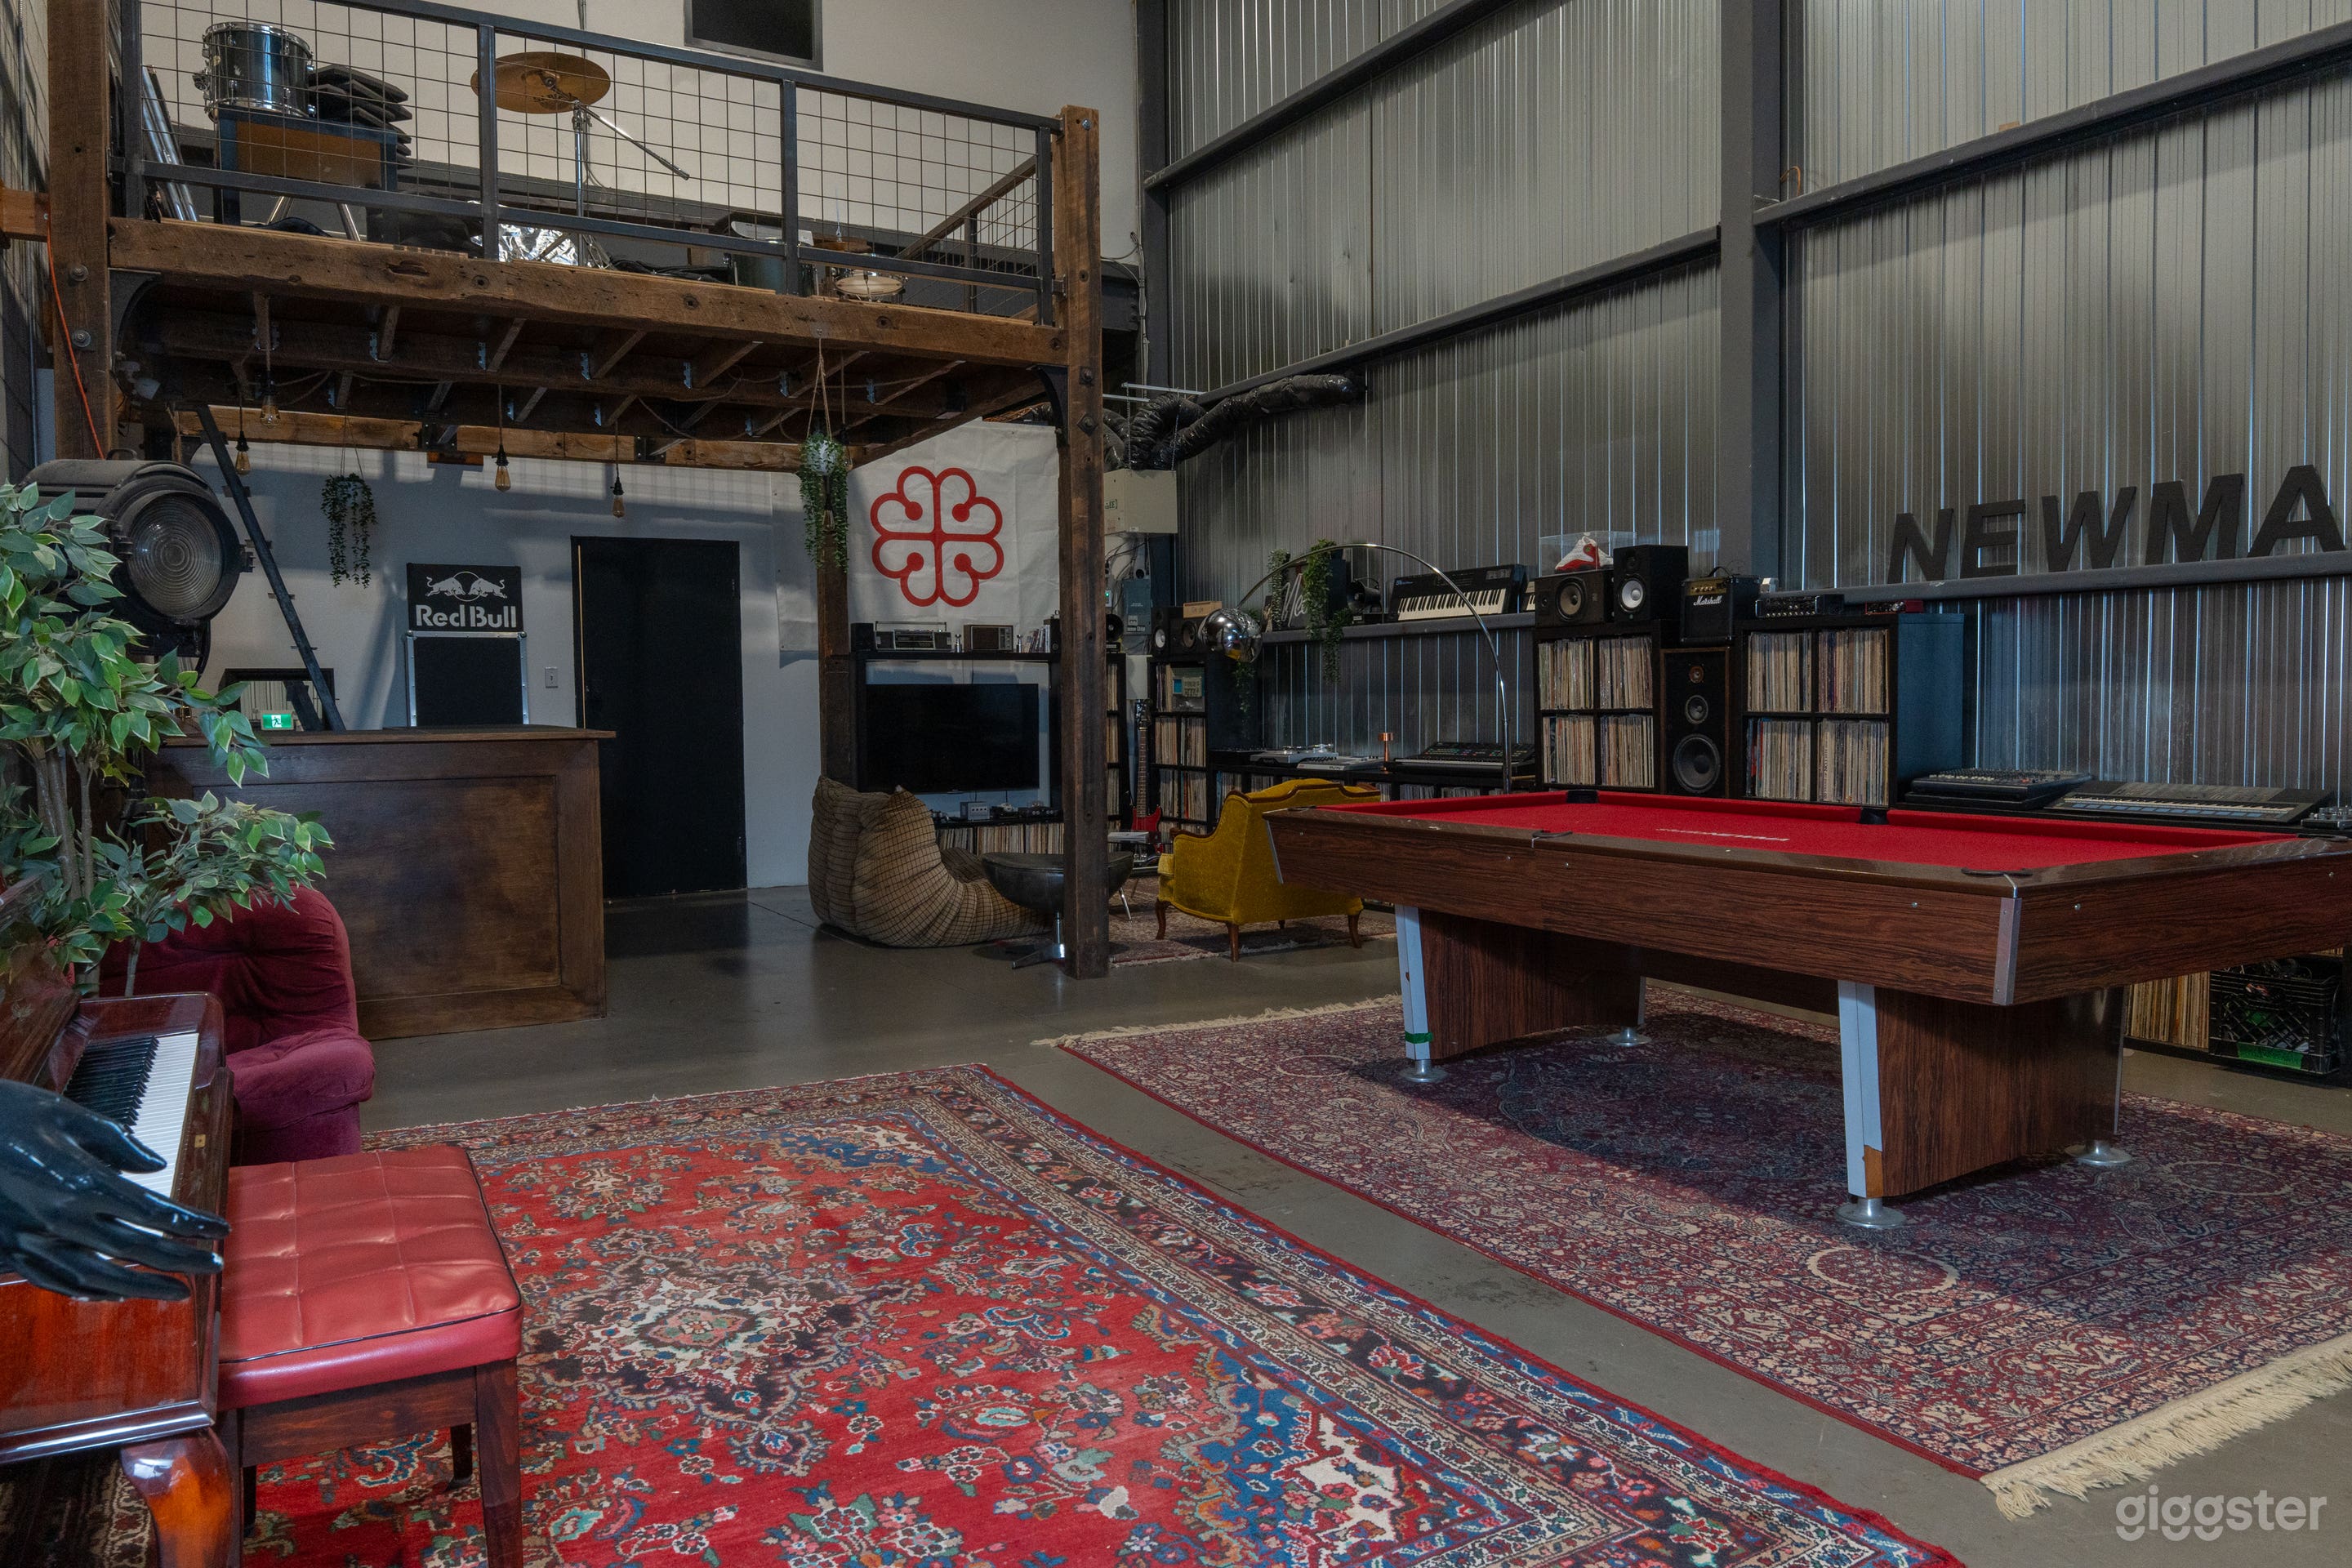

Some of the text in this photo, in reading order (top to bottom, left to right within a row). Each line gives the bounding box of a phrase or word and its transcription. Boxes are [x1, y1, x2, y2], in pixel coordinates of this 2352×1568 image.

[1886, 465, 2346, 583] NEWMA
[1693, 595, 1723, 606] Marshall
[415, 604, 517, 628] Red Bull
